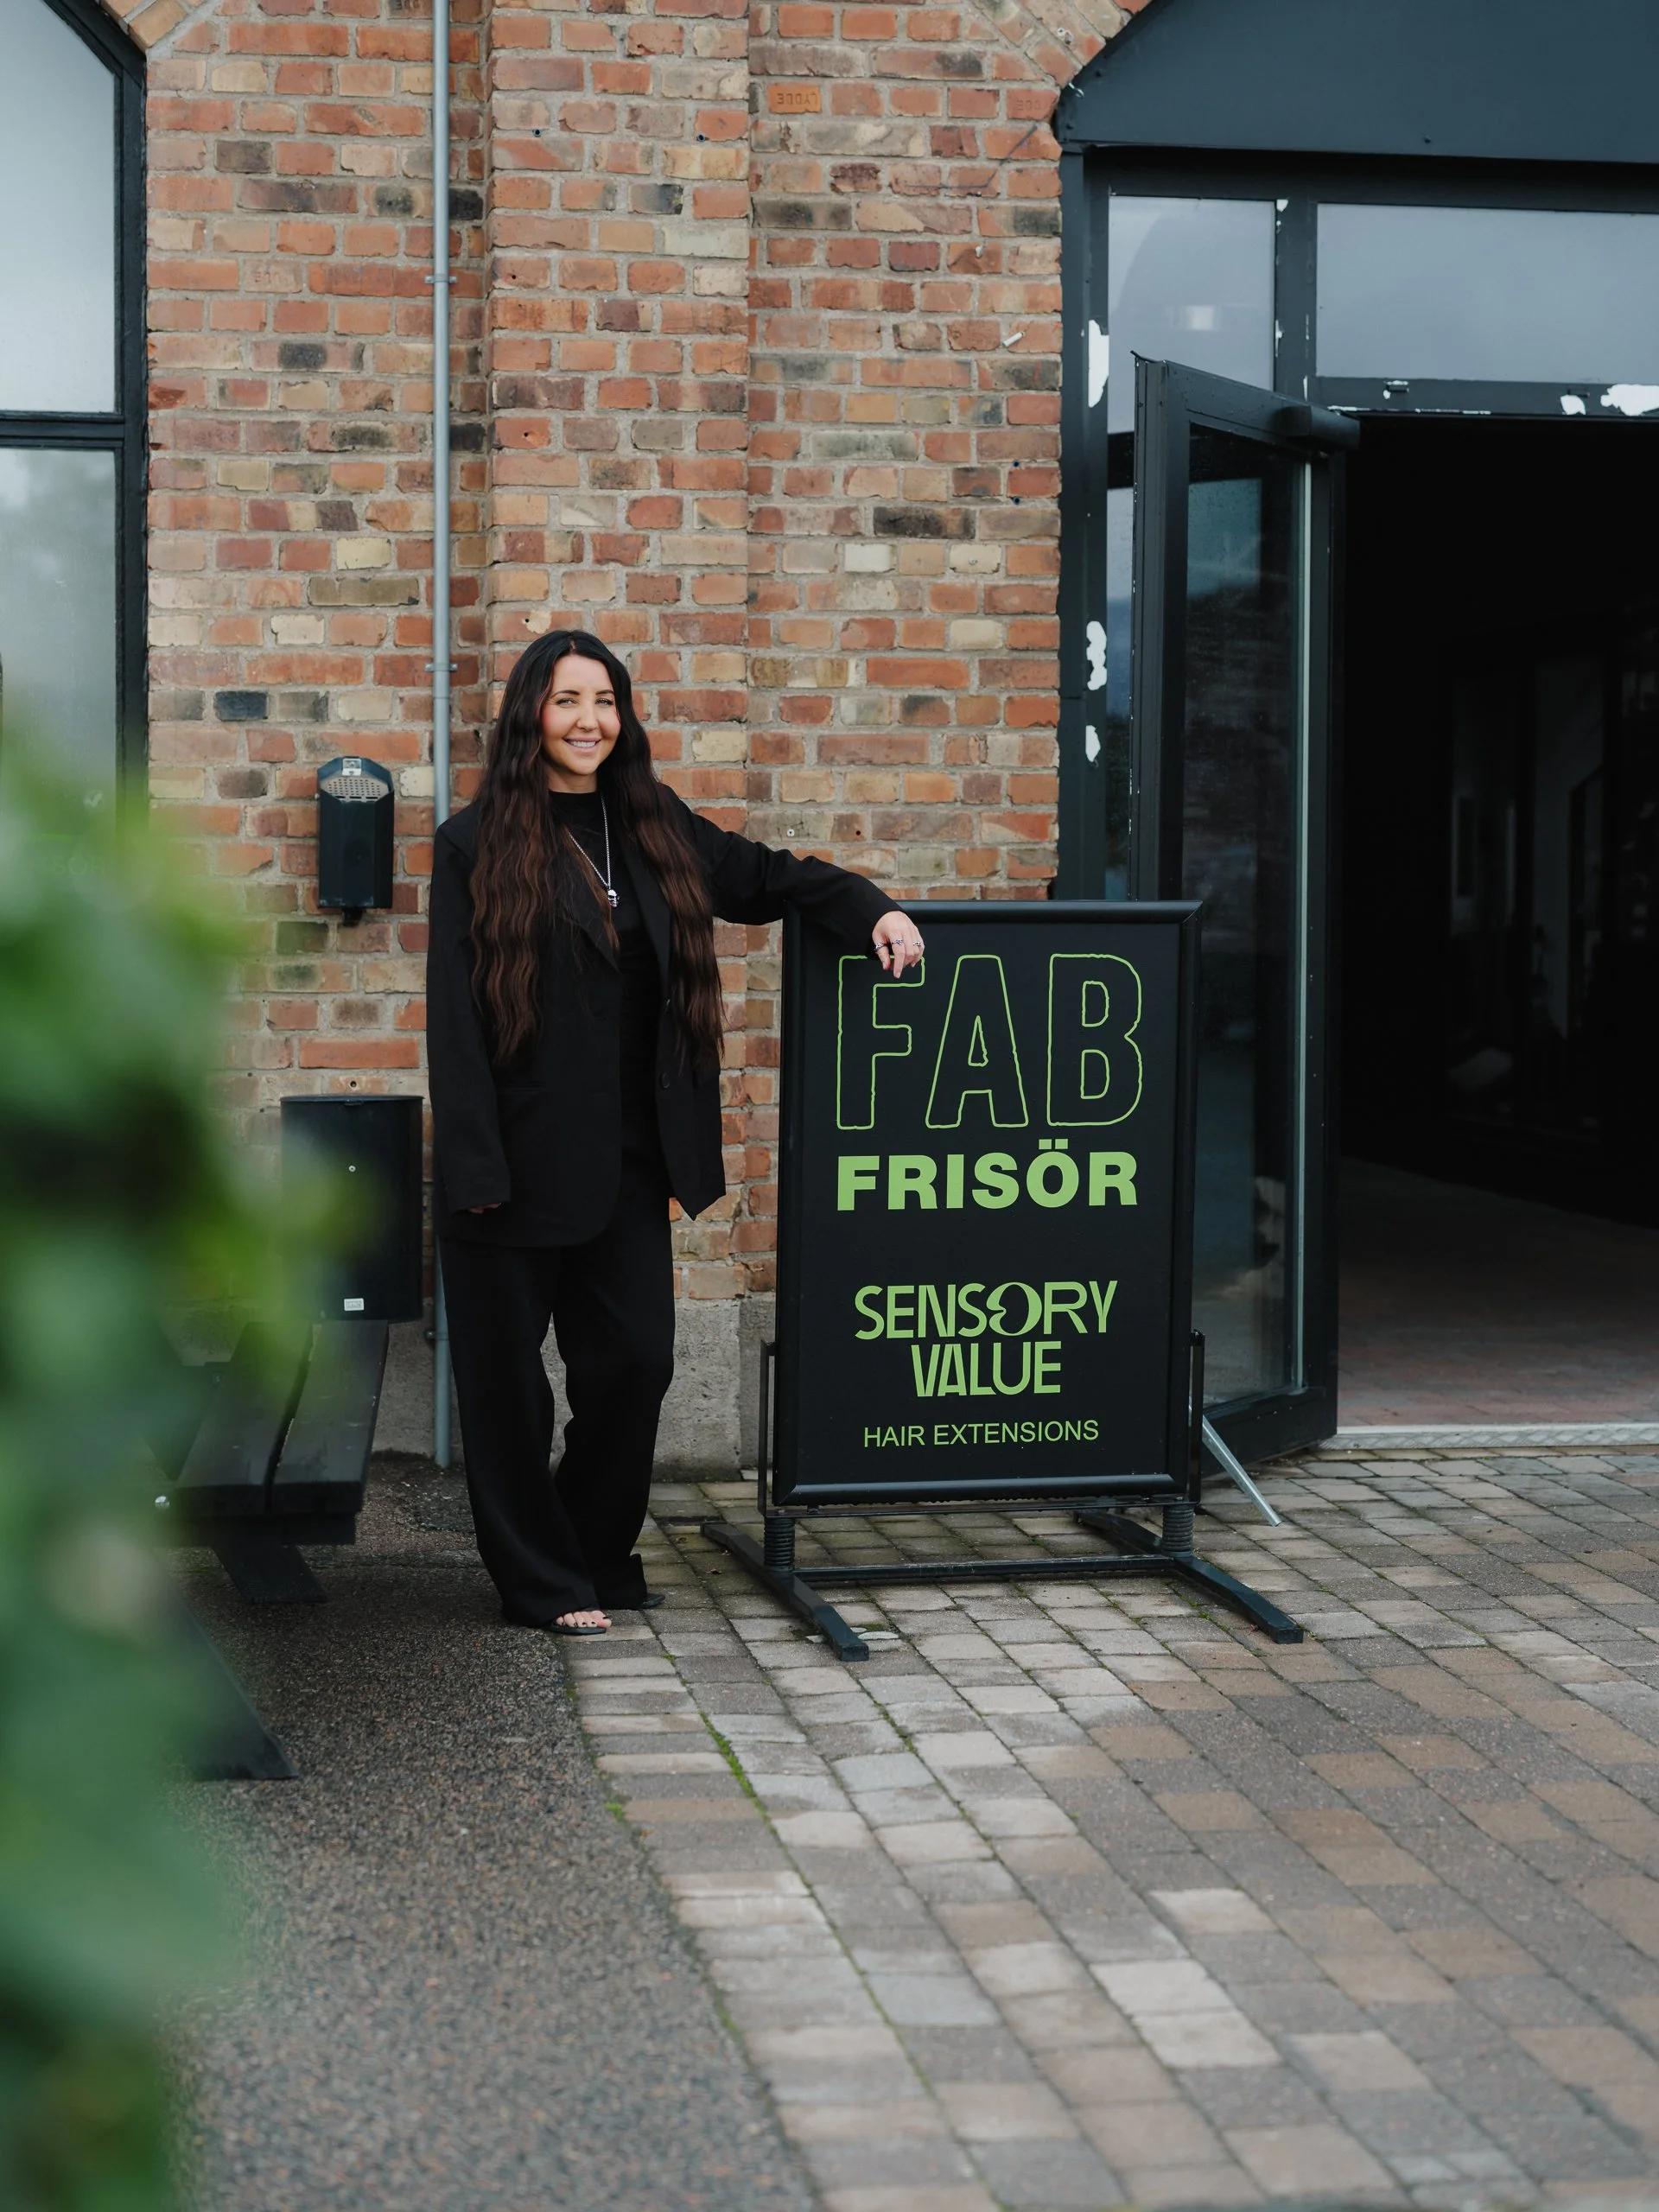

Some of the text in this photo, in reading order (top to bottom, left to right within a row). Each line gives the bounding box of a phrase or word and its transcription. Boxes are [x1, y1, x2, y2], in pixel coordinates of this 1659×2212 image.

[836, 954, 1143, 1130] FAB
[837, 1138, 1138, 1211] FRISÖR
[855, 1281, 1118, 1340] SENSORY
[911, 1341, 1062, 1397] VALUE
[865, 1420, 1099, 1448] HAIR EXTENSIONS
